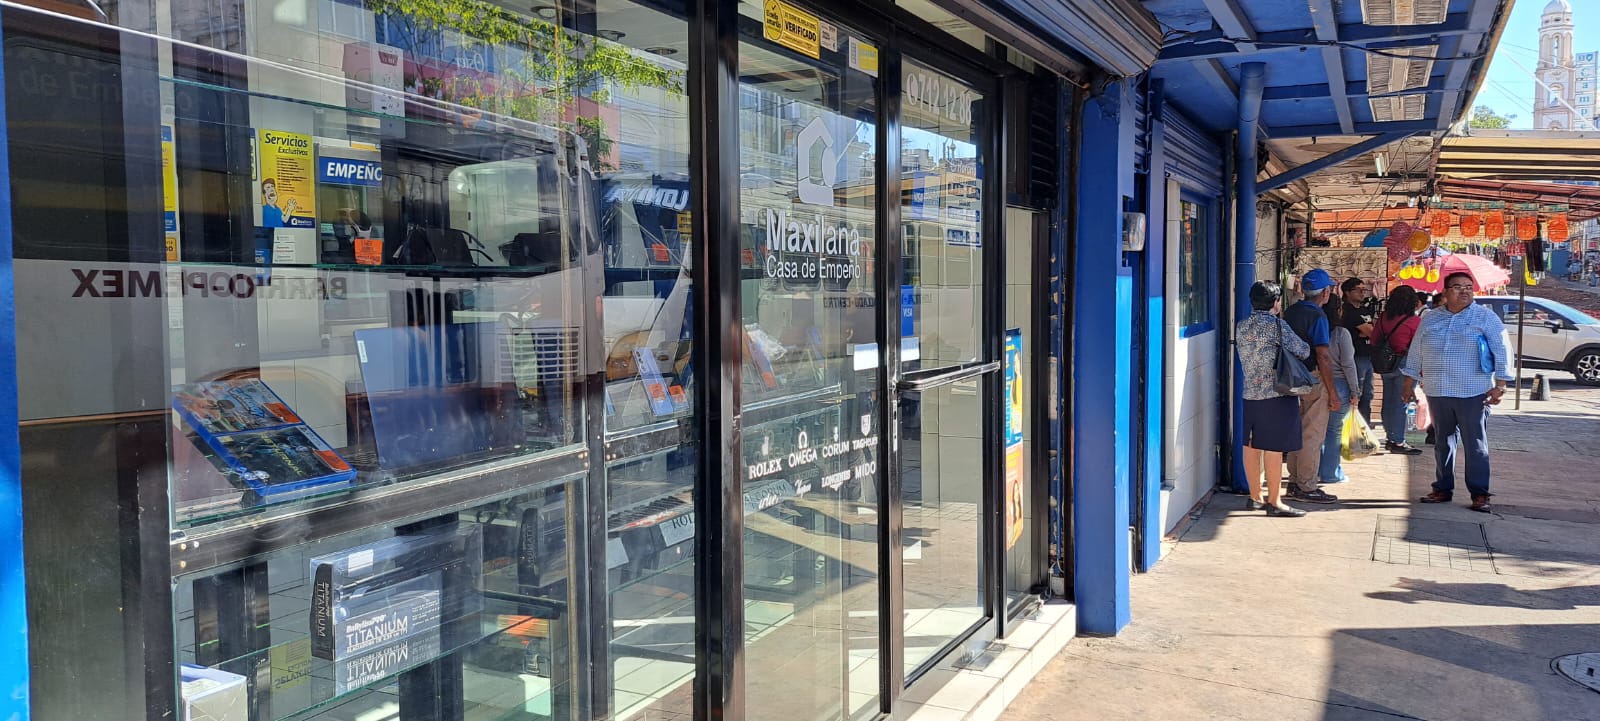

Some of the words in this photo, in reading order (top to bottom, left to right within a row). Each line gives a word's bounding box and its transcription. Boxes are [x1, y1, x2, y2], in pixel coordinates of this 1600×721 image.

[784, 20, 817, 42] VERIFICADO
[944, 83, 957, 120] 12
[960, 90, 972, 127] 88
[264, 132, 308, 148] Servicios
[277, 146, 308, 156] Exclusivos
[766, 207, 860, 256] Maxilana
[766, 254, 798, 278] Casa
[801, 257, 816, 279] de
[819, 257, 860, 284] Empeño
[902, 307, 913, 318] VISA
[748, 458, 782, 480] ROLEX
[788, 447, 818, 468] OMEGA
[822, 440, 850, 458] CORUM
[855, 460, 876, 479] MIDO
[317, 582, 327, 638] TITANIUM
[345, 614, 408, 649] TITANIUM
